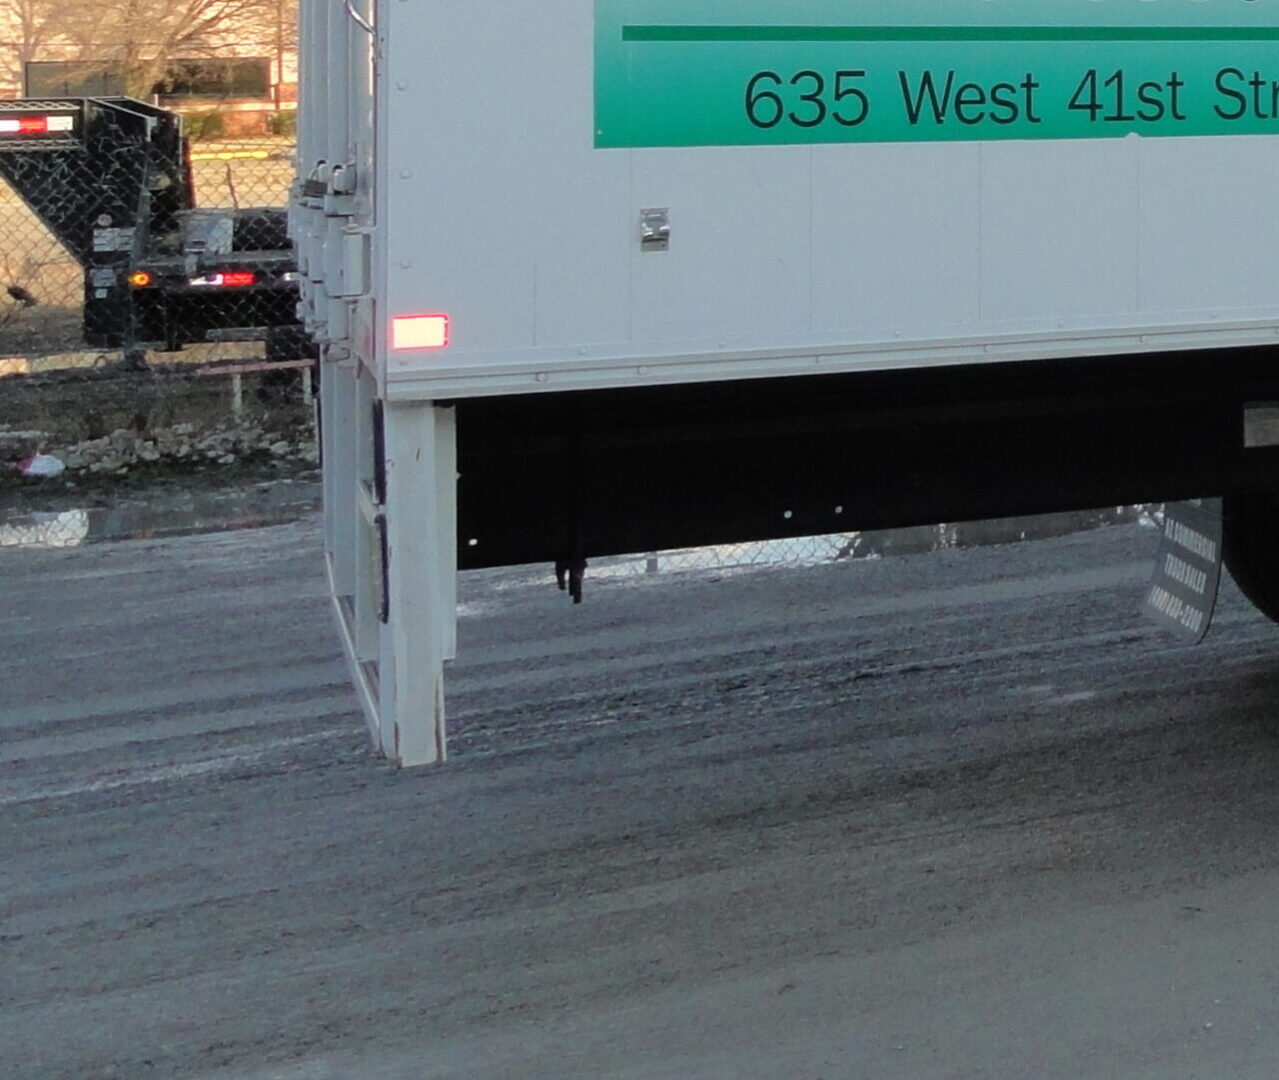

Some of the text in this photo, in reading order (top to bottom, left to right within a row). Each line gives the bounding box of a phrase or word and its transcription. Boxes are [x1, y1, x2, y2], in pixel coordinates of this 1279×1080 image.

[745, 70, 869, 129] 635
[898, 70, 1041, 126] West
[1067, 69, 1187, 123] 41st
